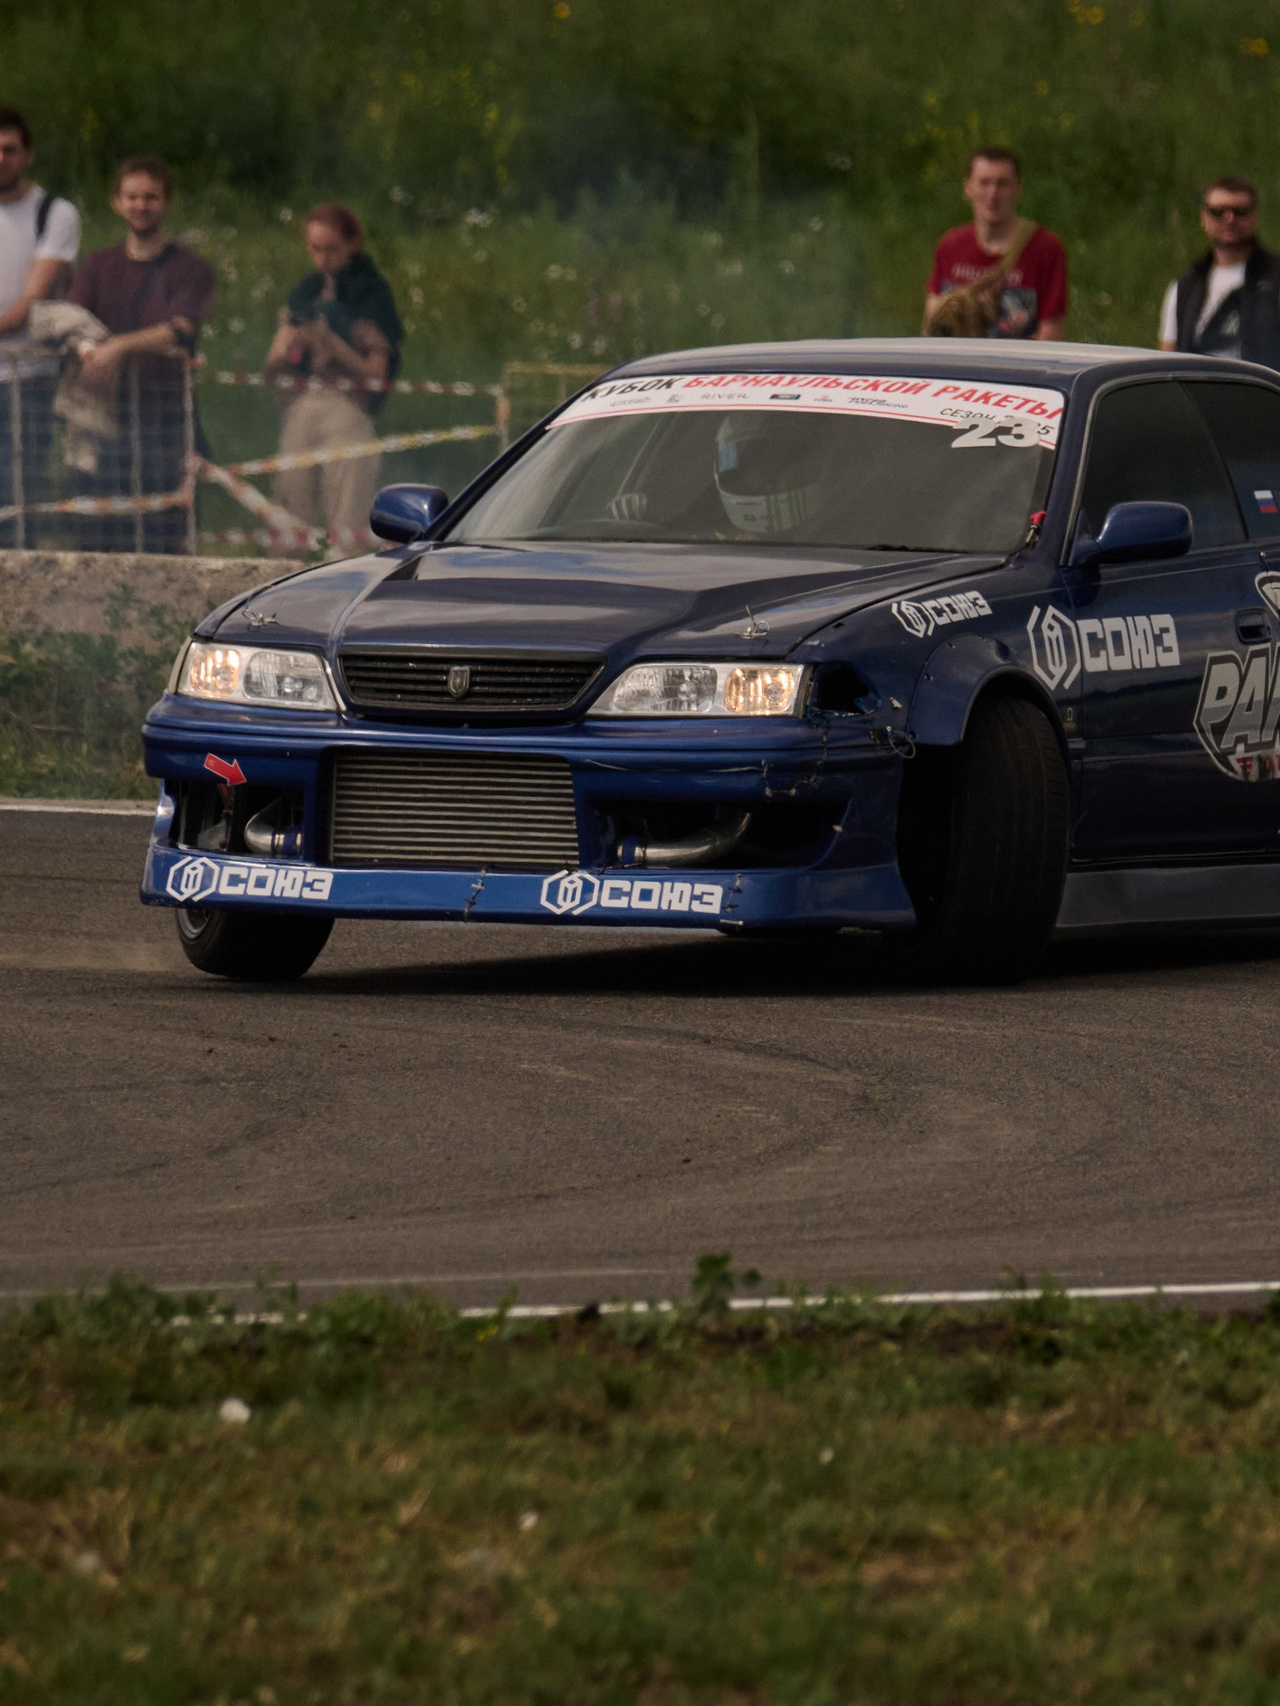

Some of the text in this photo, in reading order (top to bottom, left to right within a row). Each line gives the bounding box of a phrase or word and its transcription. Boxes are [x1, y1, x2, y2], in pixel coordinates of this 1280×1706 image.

[581, 375, 1063, 420] КУБОК БАРНАУЛЬСКОЙ РАКЕТЫ
[951, 416, 1042, 449] 23
[921, 591, 993, 626] СОЮЗ
[1075, 613, 1180, 673] СОЮЗ
[219, 866, 334, 901] СОЮЗ
[600, 879, 724, 914] СОЮЗ
